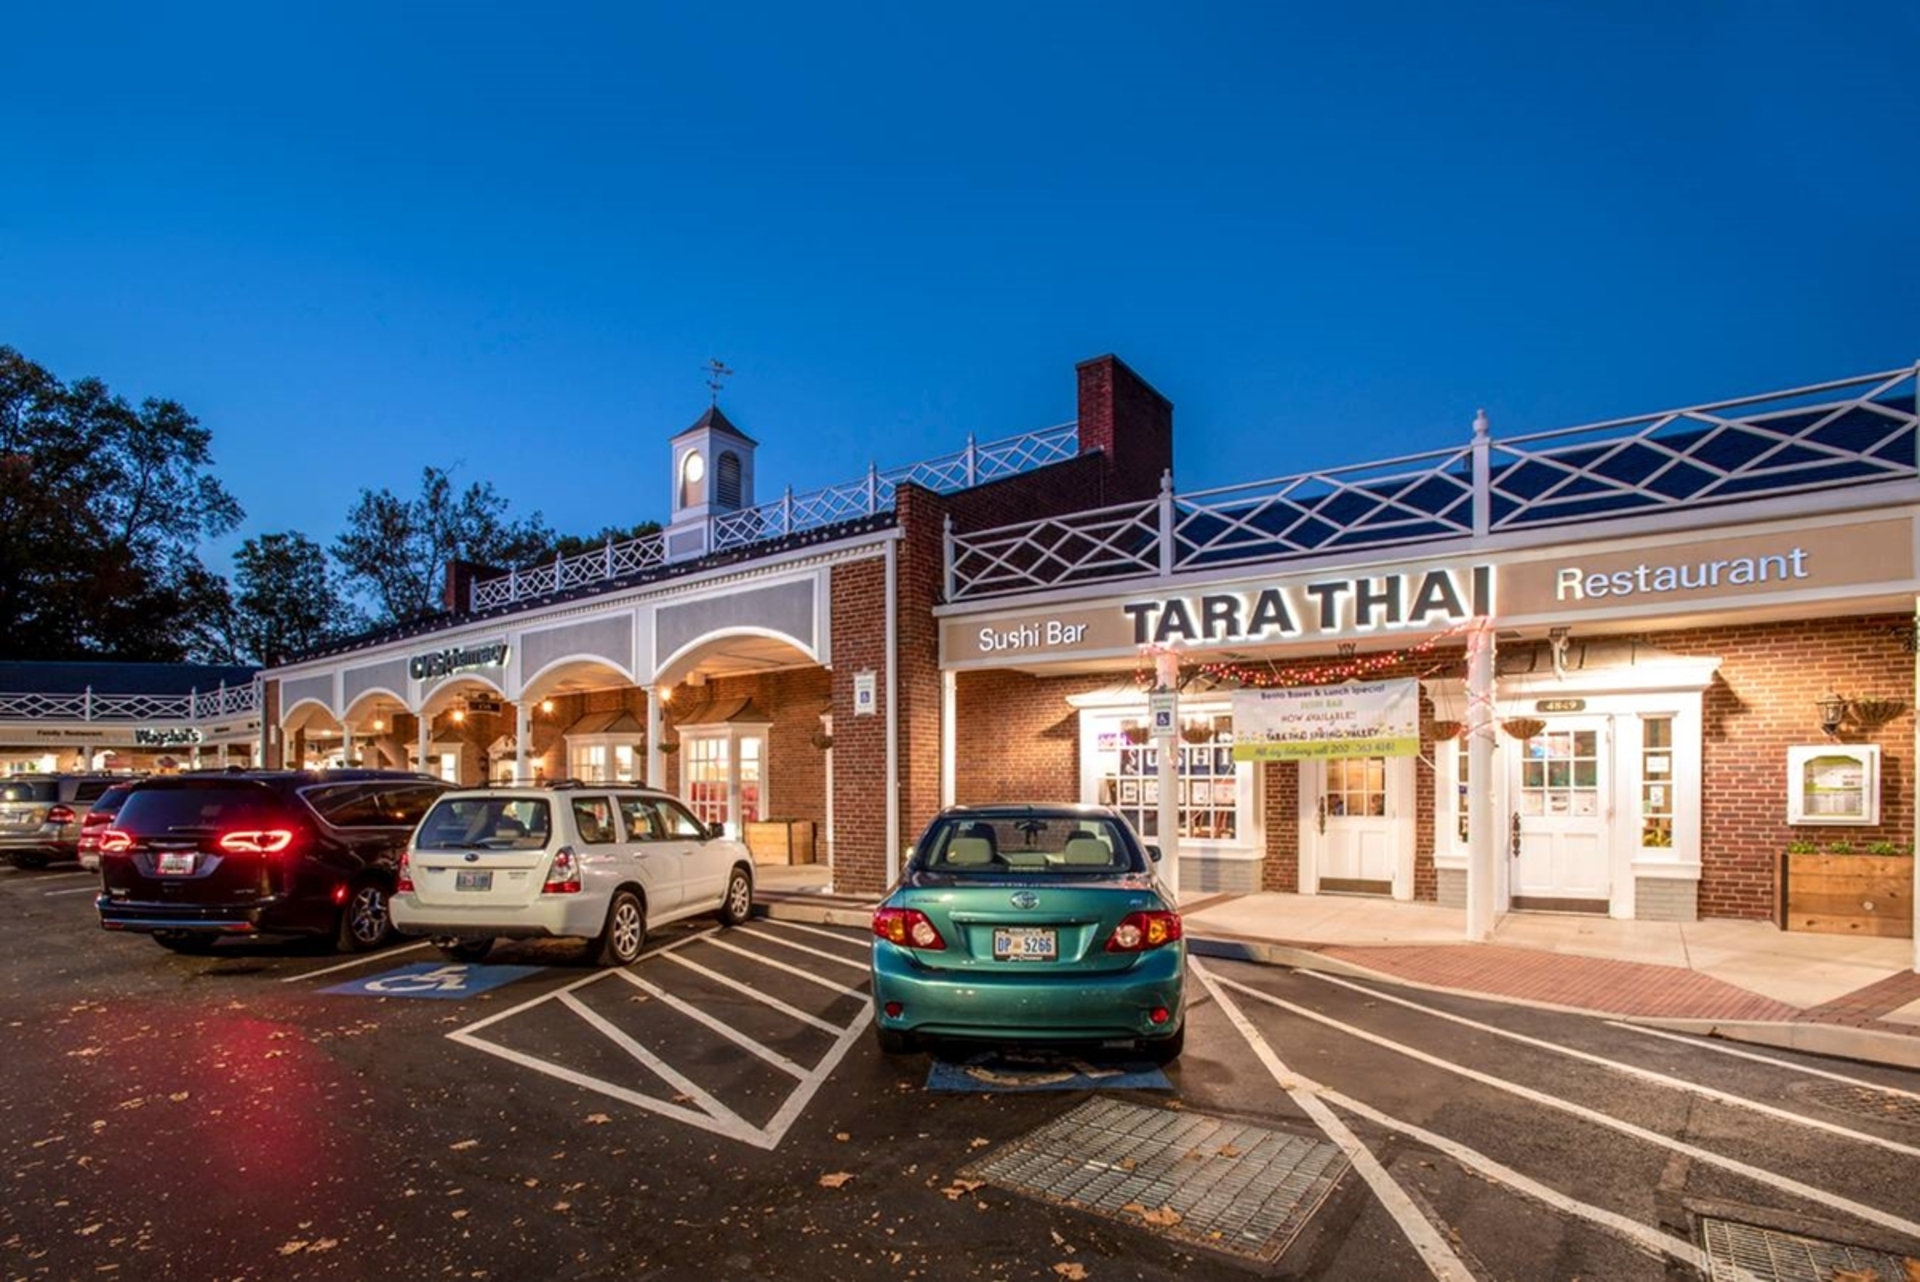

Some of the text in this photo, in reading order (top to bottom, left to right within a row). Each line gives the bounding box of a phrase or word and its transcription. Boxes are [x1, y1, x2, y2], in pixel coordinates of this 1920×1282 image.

[1556, 547, 1808, 600] Restaurant
[1124, 564, 1494, 644] TARA THAI
[979, 621, 1087, 652] Sushi Bar
[1314, 689, 1321, 697] &
[1324, 687, 1349, 697] Lunch
[1351, 684, 1385, 695] Special
[1346, 726, 1380, 738] VALLEY
